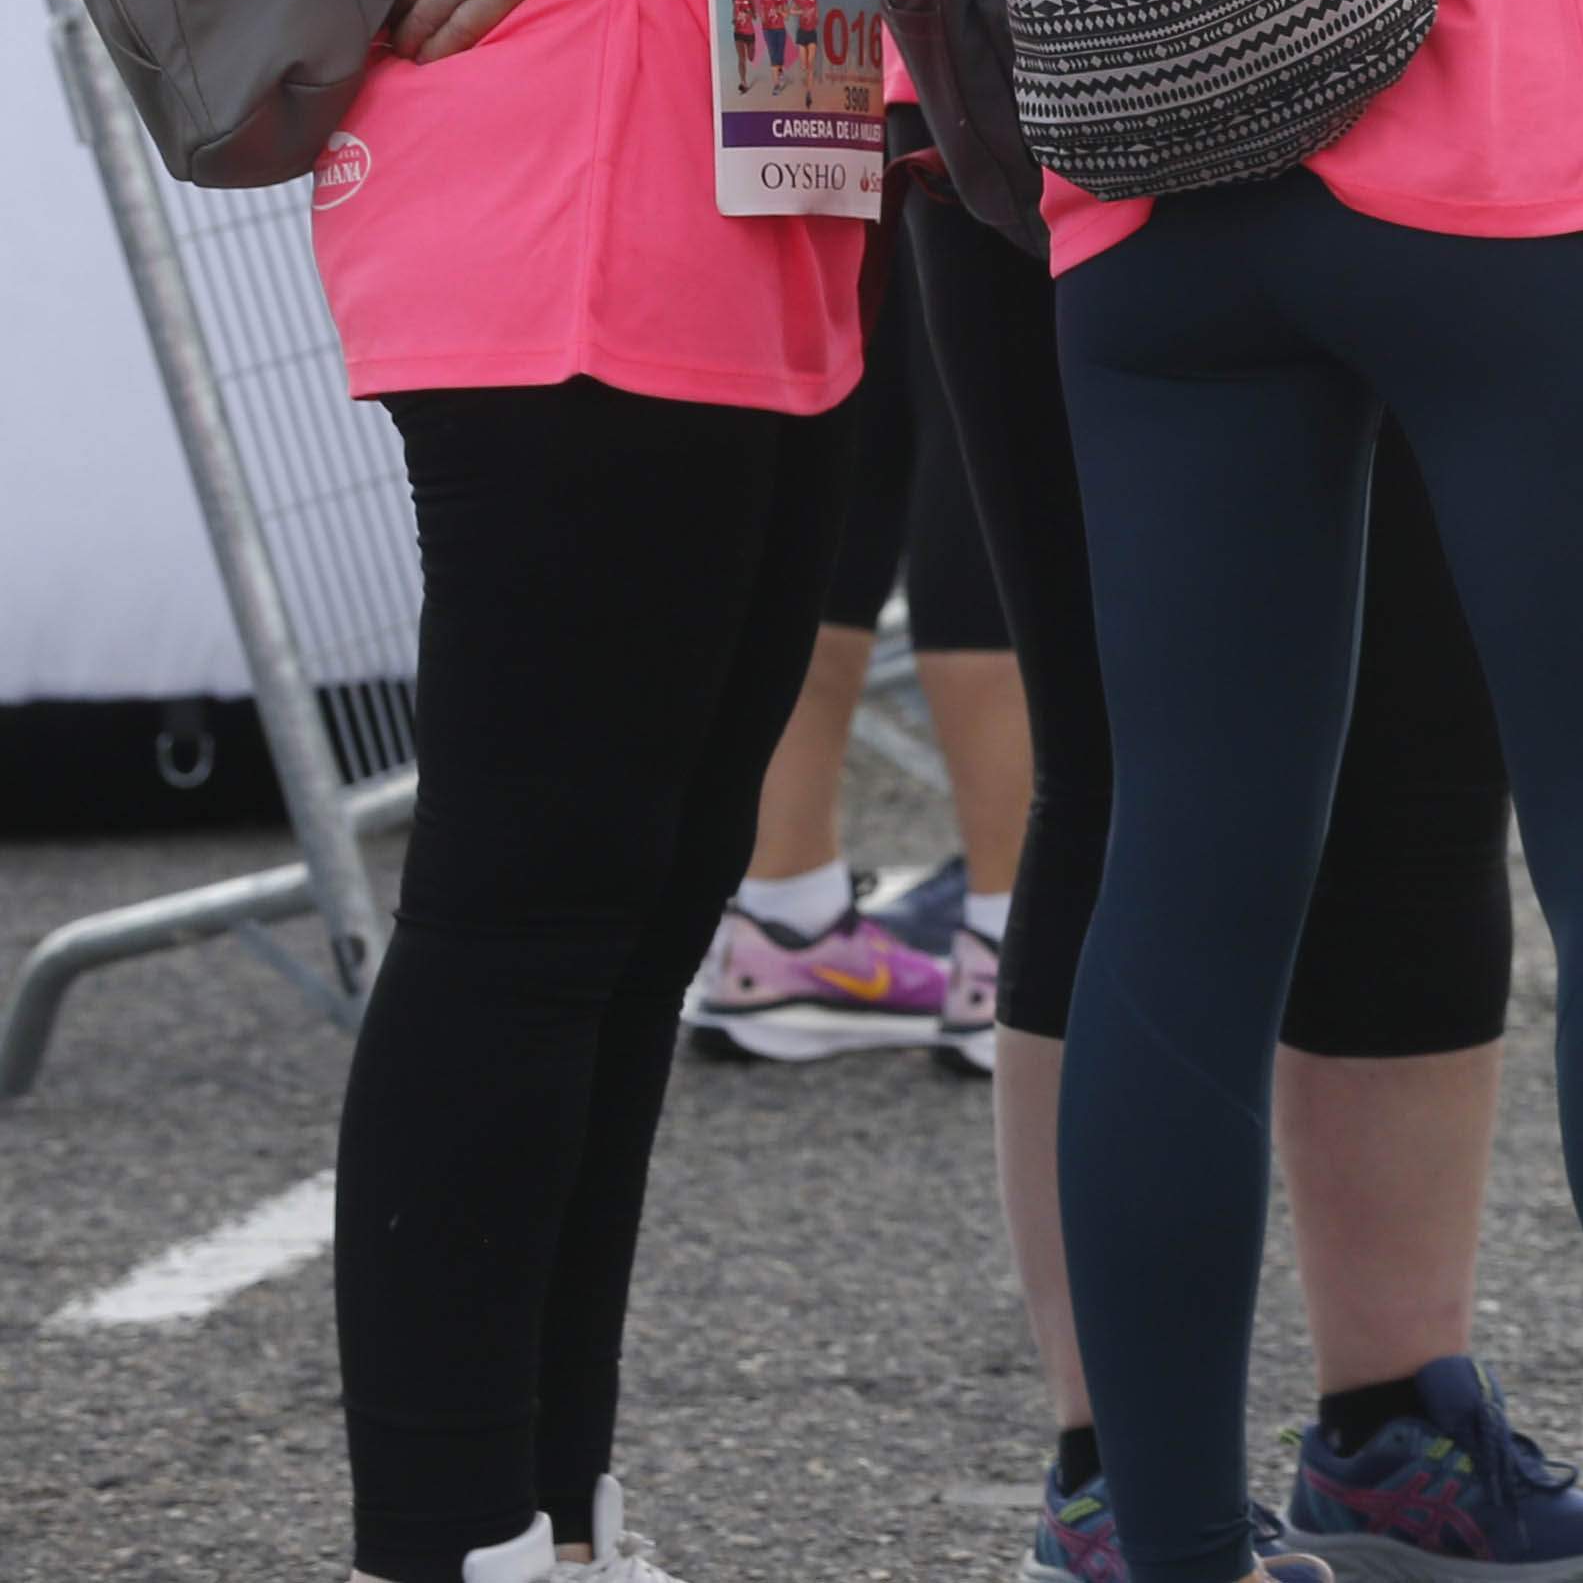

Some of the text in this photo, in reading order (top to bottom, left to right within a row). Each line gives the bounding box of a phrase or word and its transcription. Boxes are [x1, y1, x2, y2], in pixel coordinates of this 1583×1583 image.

[823, 8, 882, 68] 016
[772, 118, 834, 139] CARRERA
[836, 120, 850, 140] DE
[761, 162, 847, 191] OYSHO
